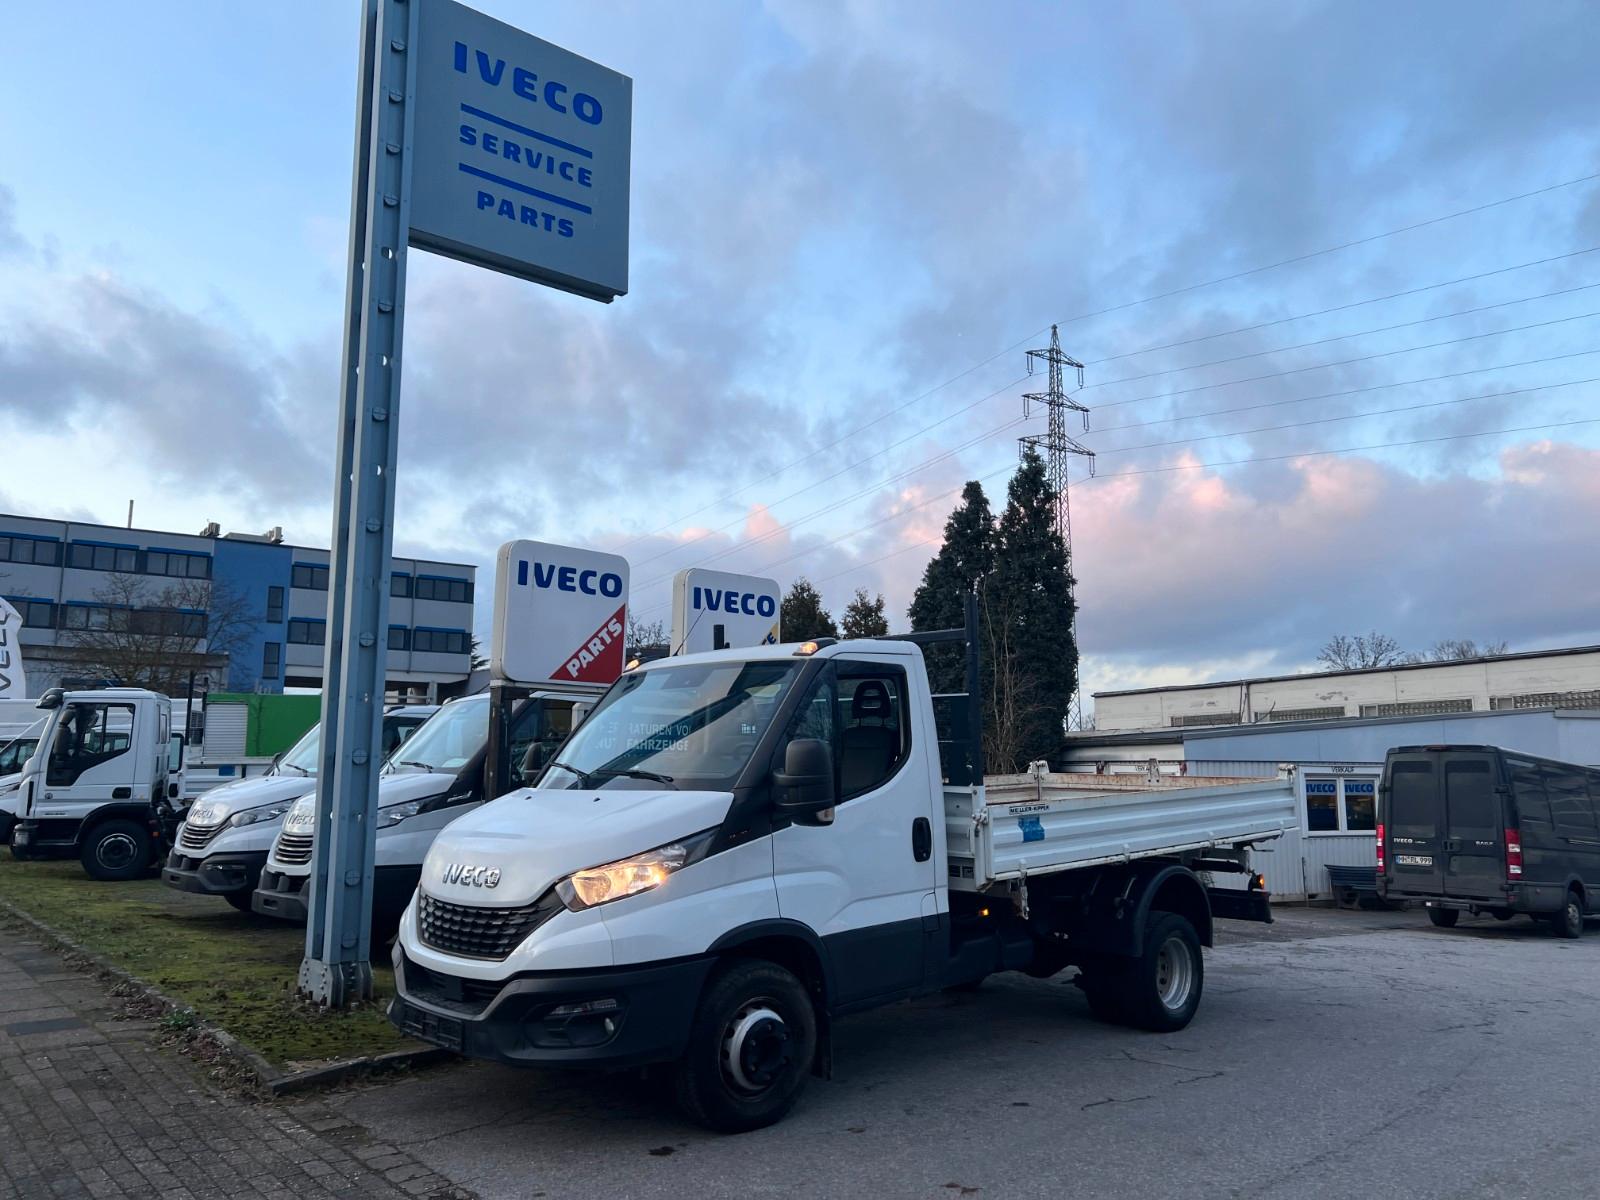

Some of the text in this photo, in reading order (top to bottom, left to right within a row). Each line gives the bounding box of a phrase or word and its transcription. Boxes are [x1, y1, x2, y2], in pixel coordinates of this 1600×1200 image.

[454, 41, 603, 126] IVECO
[459, 125, 593, 188] SERVICE
[477, 190, 574, 238] PARTS
[517, 559, 623, 598] IVECO
[693, 586, 776, 618] IVECO
[565, 617, 623, 679] PARTS
[1306, 783, 1336, 793] IVECO
[1344, 783, 1374, 793] IVECO
[442, 863, 501, 888] IVECO
